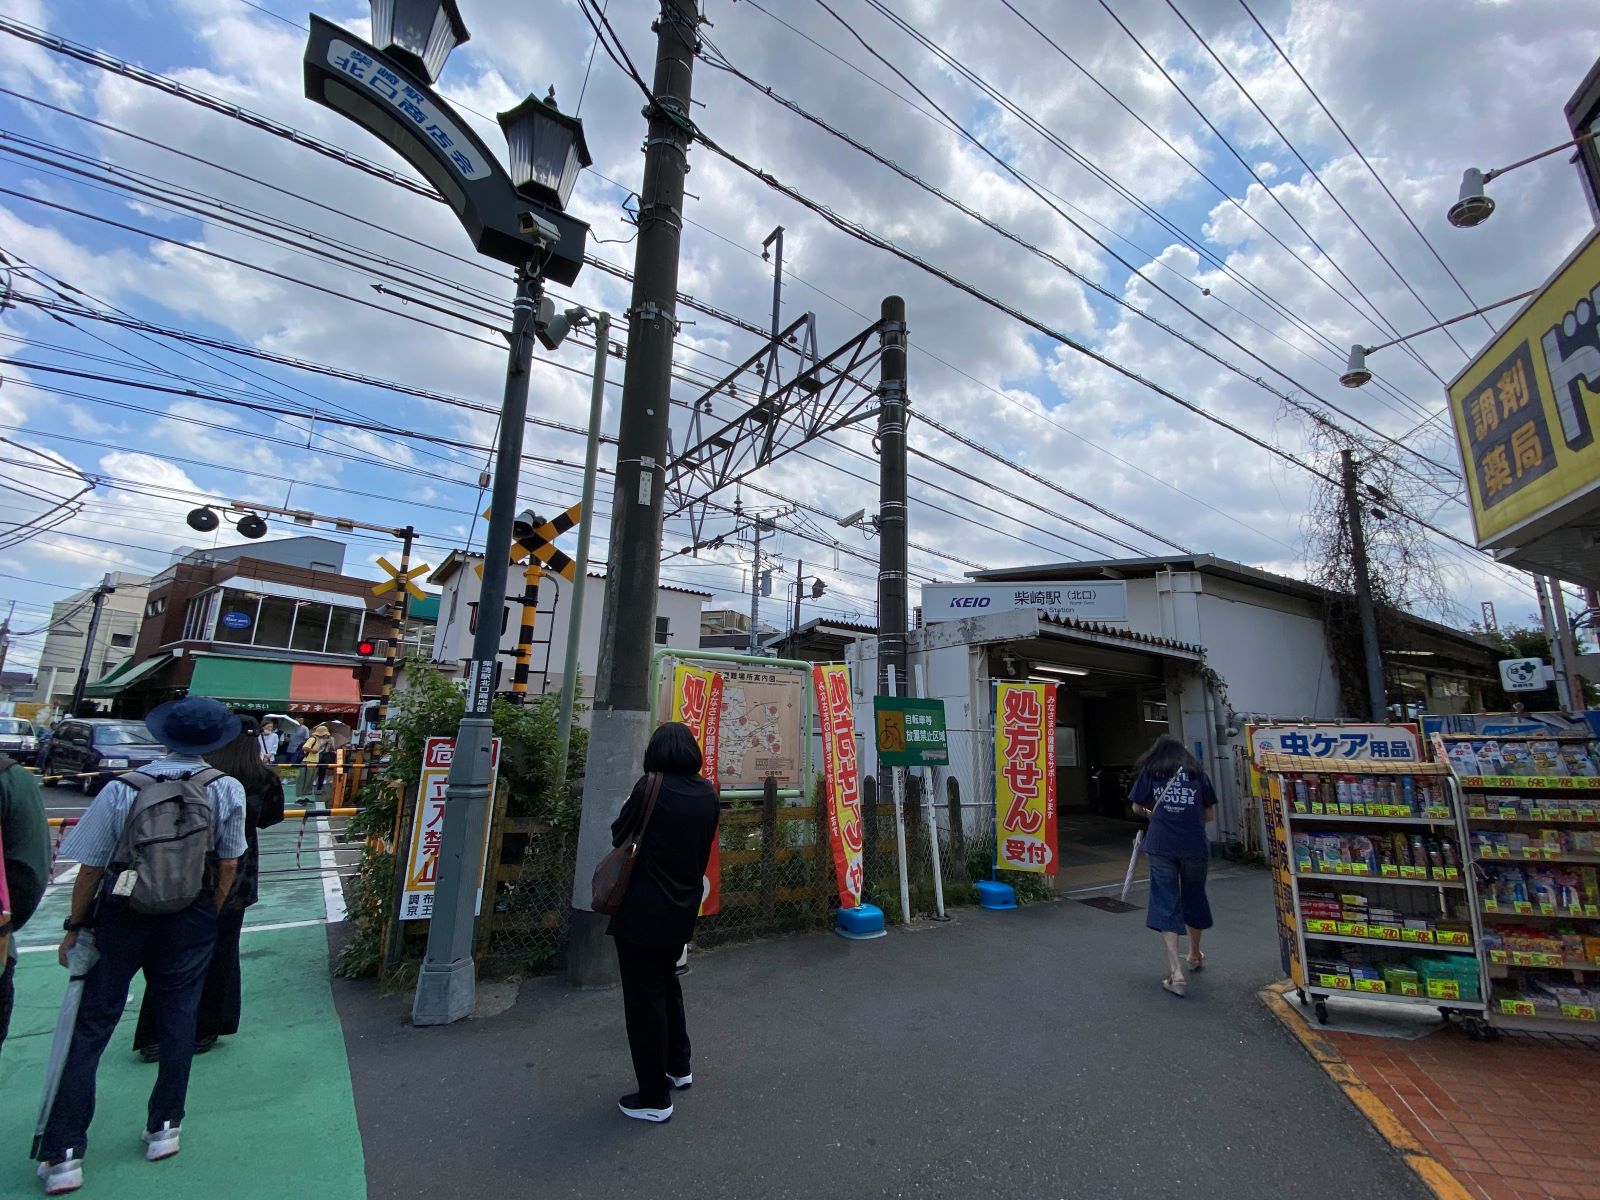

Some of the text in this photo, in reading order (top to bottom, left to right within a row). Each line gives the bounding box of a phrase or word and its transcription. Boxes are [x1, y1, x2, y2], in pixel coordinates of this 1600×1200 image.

[350, 50, 424, 105] 柴崎駅
[335, 56, 475, 176] 北口商店会
[1470, 357, 1530, 442] 調剤
[1480, 418, 1544, 498] 薬局
[950, 597, 991, 608] KEIO
[1014, 590, 1062, 606] 柴崎駅
[289, 703, 323, 712] アオキ
[1002, 687, 1042, 834] 処方せん
[1279, 732, 1411, 759] 虫ケア用品
[1005, 838, 1048, 865] 受付
